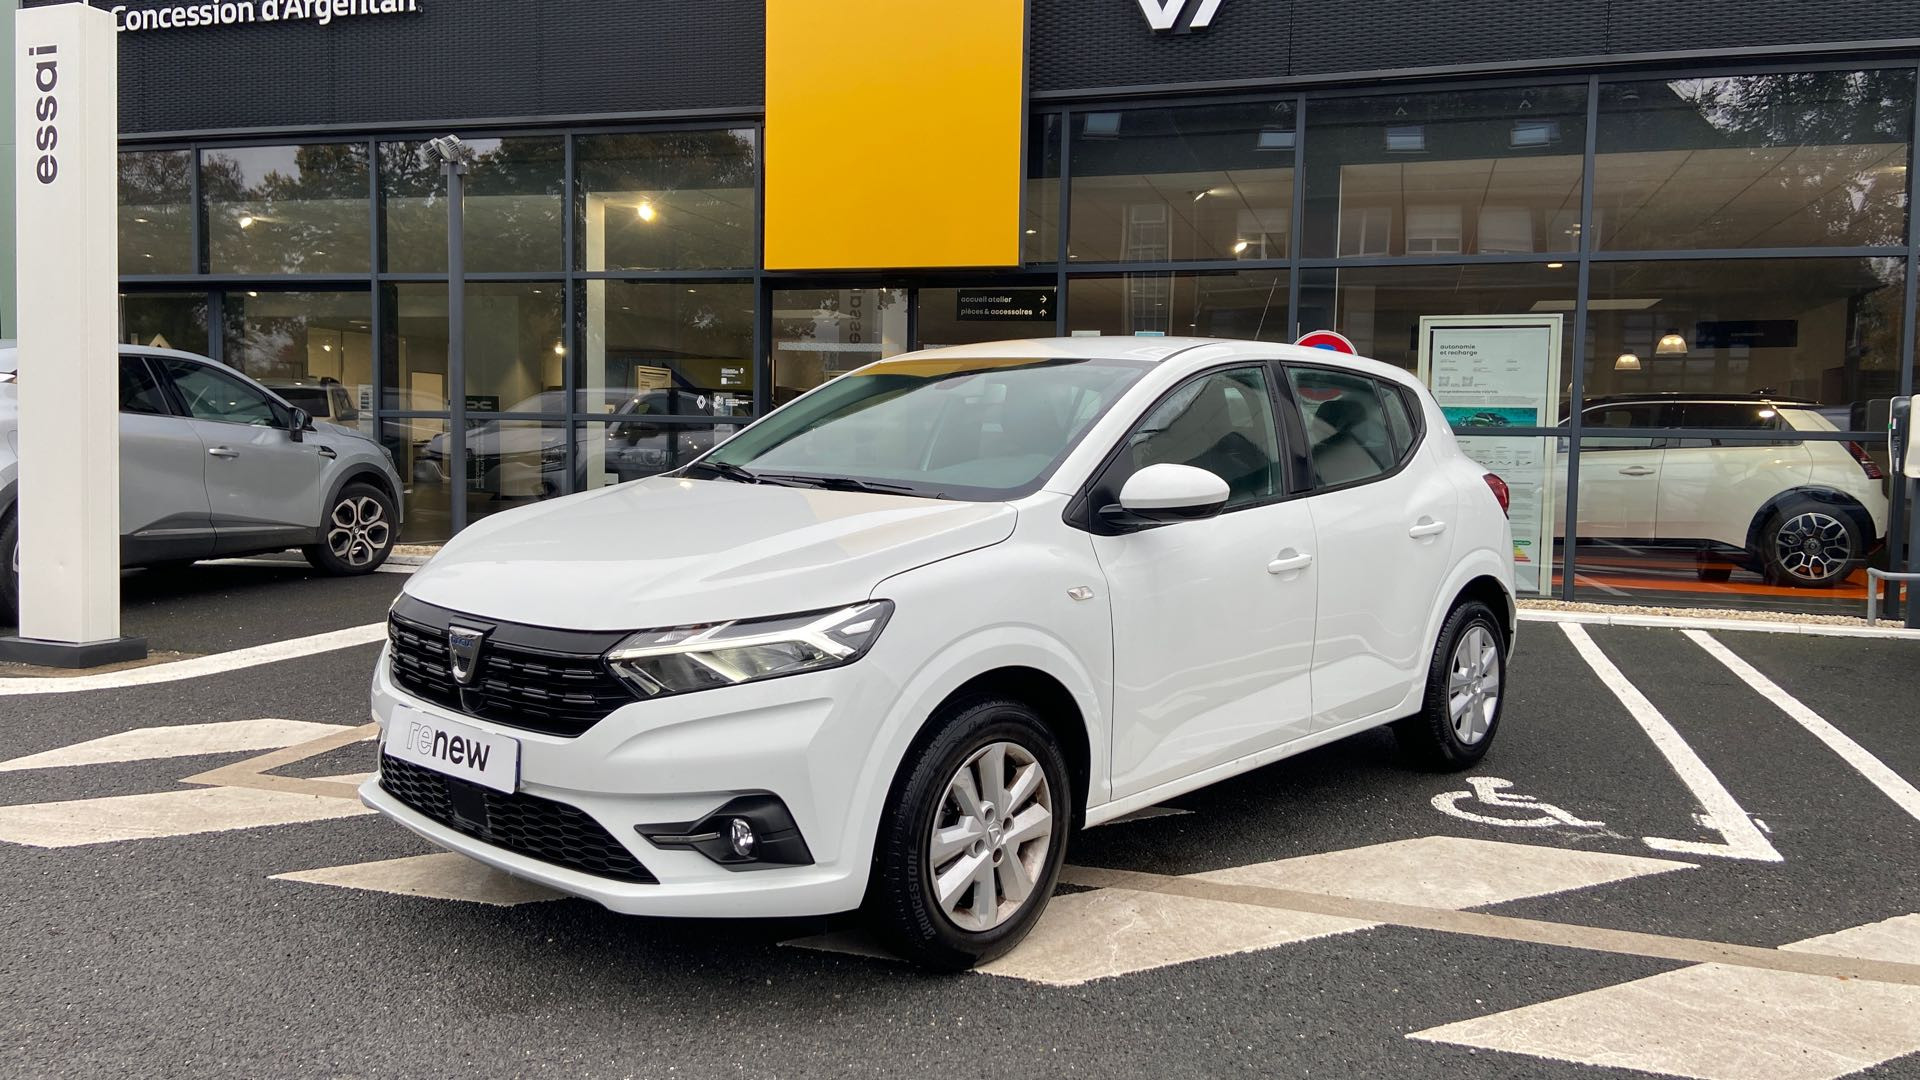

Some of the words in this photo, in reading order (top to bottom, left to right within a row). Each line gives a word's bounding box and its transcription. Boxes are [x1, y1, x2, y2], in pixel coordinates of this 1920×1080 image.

[111, 0, 254, 31] Concession
[28, 45, 58, 184] essai
[960, 308, 983, 316] pièces
[990, 308, 1033, 316] accessoires
[406, 722, 490, 772] renew
[907, 846, 938, 940] BRIDGESTONE
